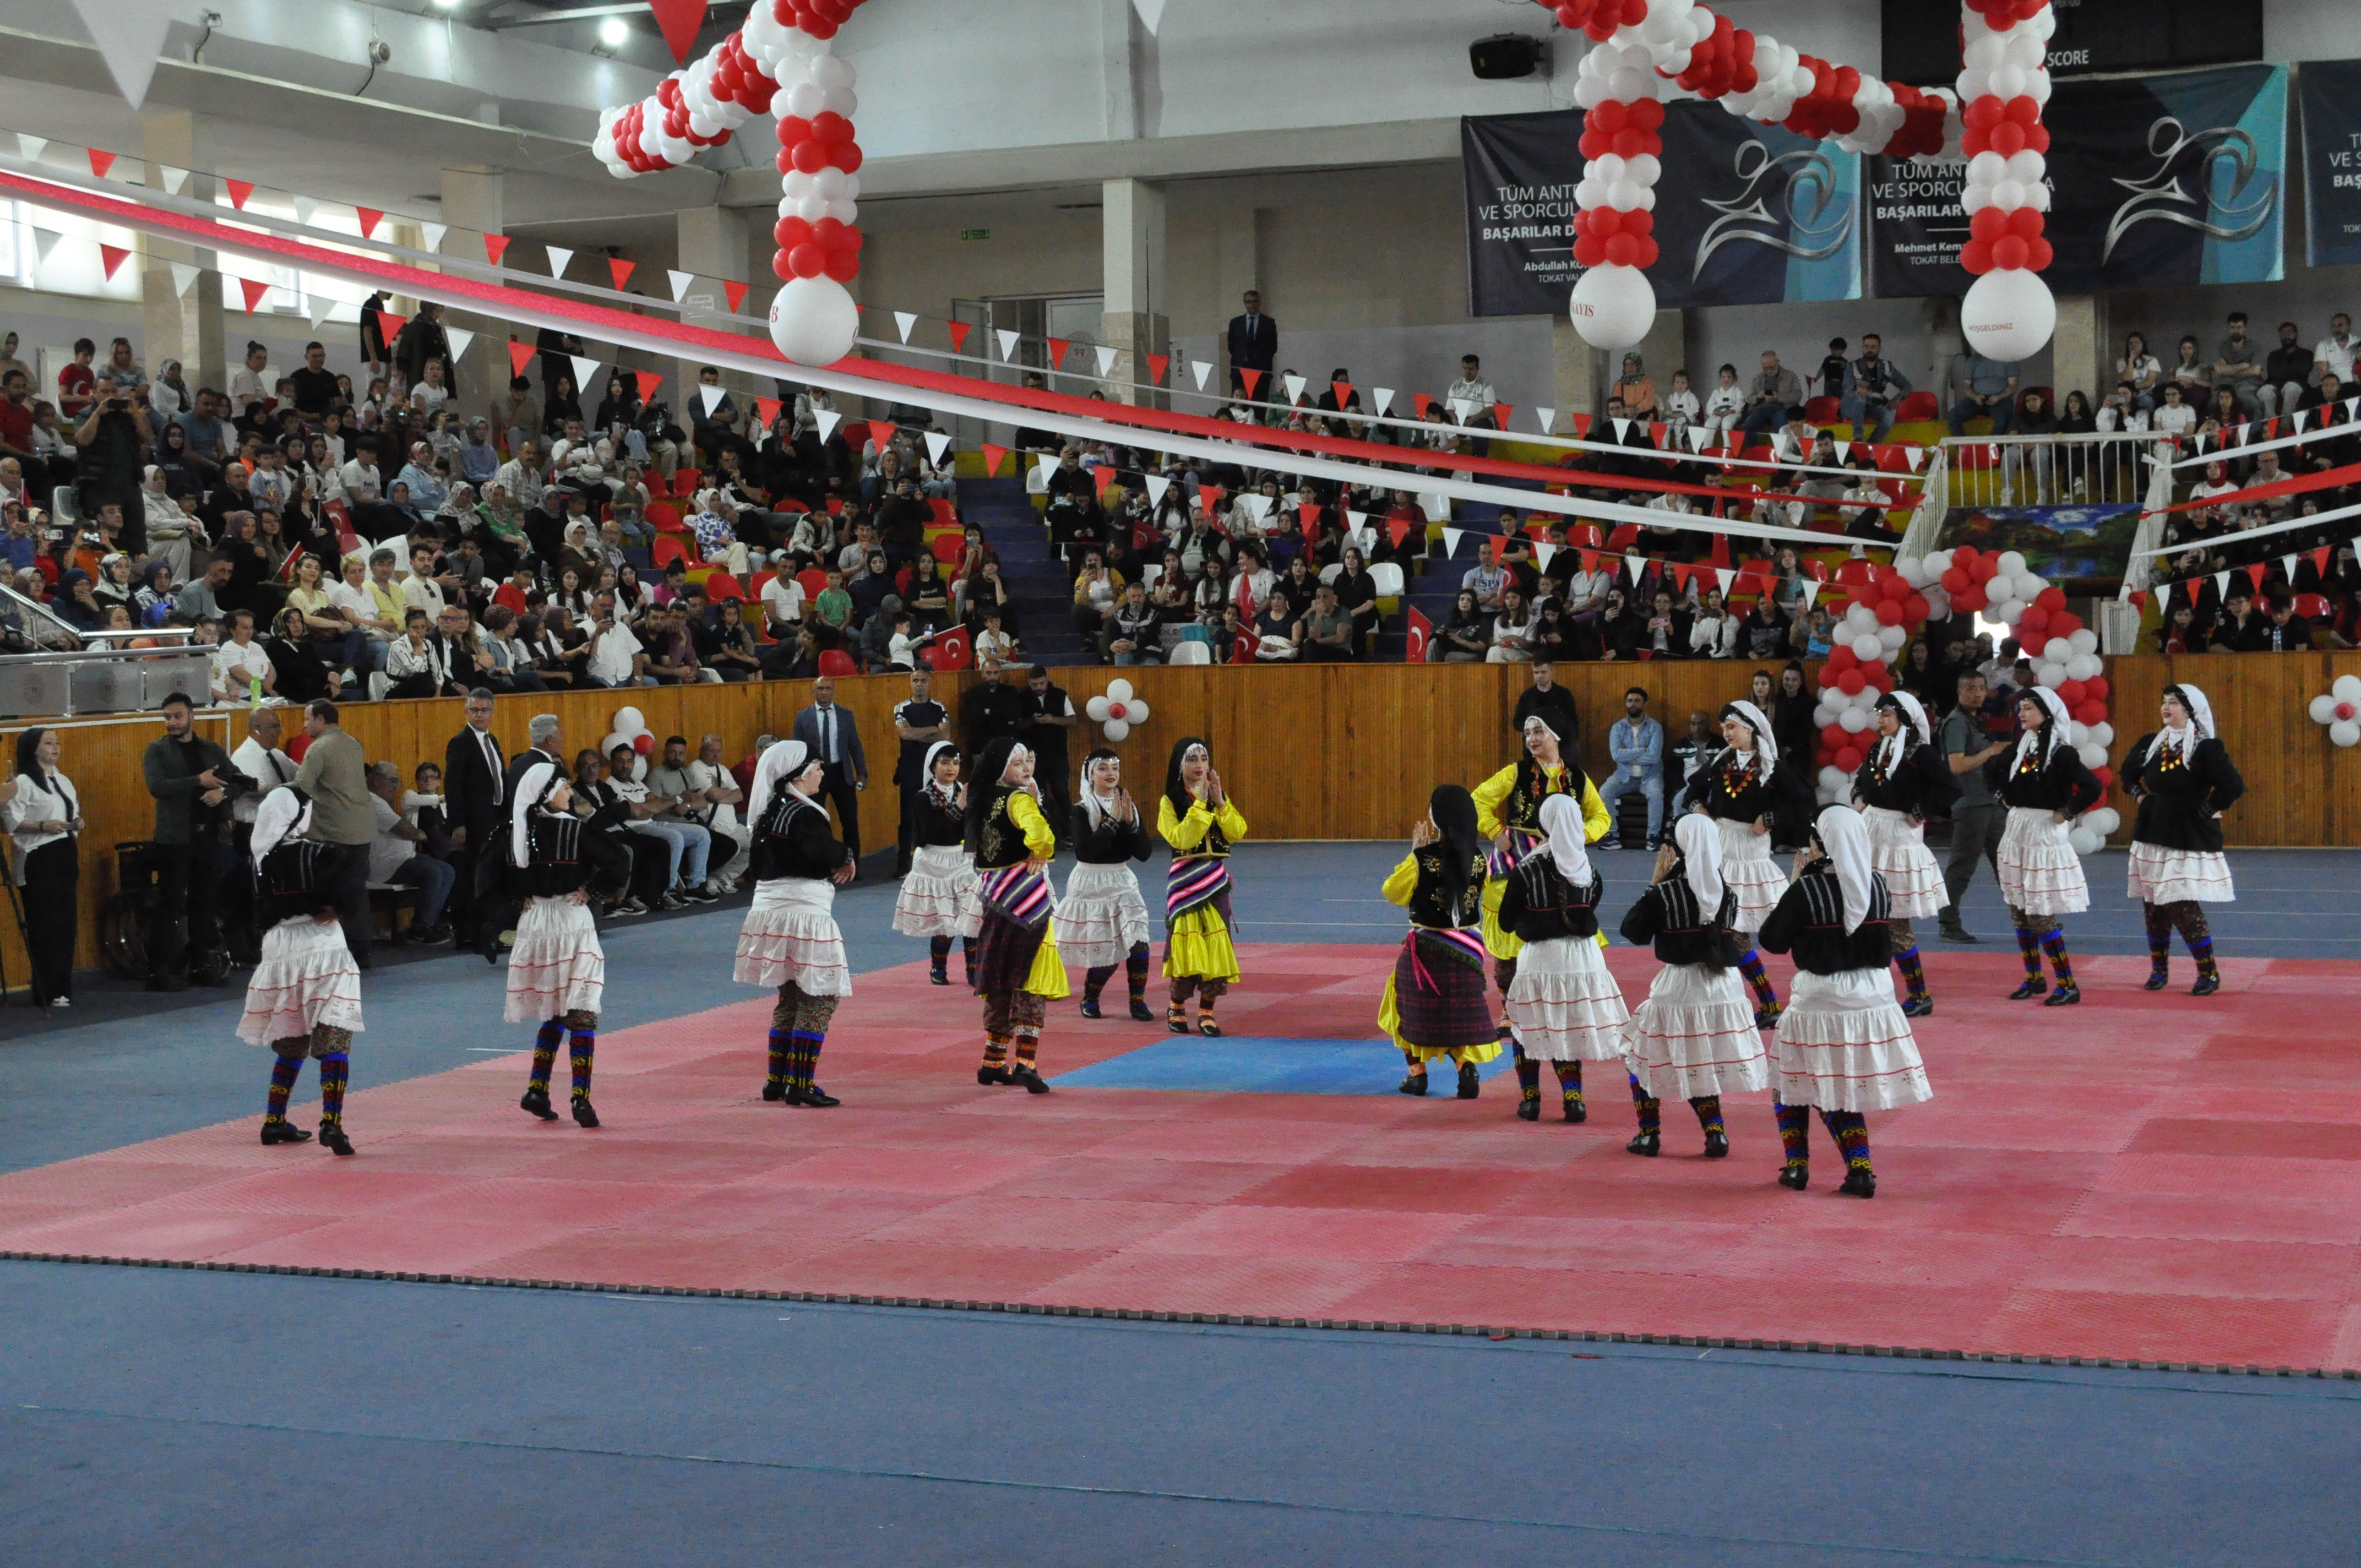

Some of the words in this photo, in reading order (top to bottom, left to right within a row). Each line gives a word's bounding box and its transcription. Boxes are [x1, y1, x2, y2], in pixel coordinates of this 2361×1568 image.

[2047, 50, 2090, 67] SCORE
[2329, 152, 2351, 167] VE
[1892, 162, 1932, 179] TÜM
[1938, 164, 1962, 178] AN
[1497, 184, 1534, 202] TÜM
[1872, 183, 1894, 199] VE
[1898, 180, 1966, 198] SPORCU
[1479, 205, 1499, 220] VE
[1876, 204, 1962, 221] BAŞARILAR
[1483, 225, 1562, 242] BAŞARILAR
[1895, 243, 1936, 253] Mehmet
[1524, 260, 1568, 271] Abdullah
[1910, 255, 1938, 265] TOKAT
[1538, 274, 1565, 283] TOKAT
